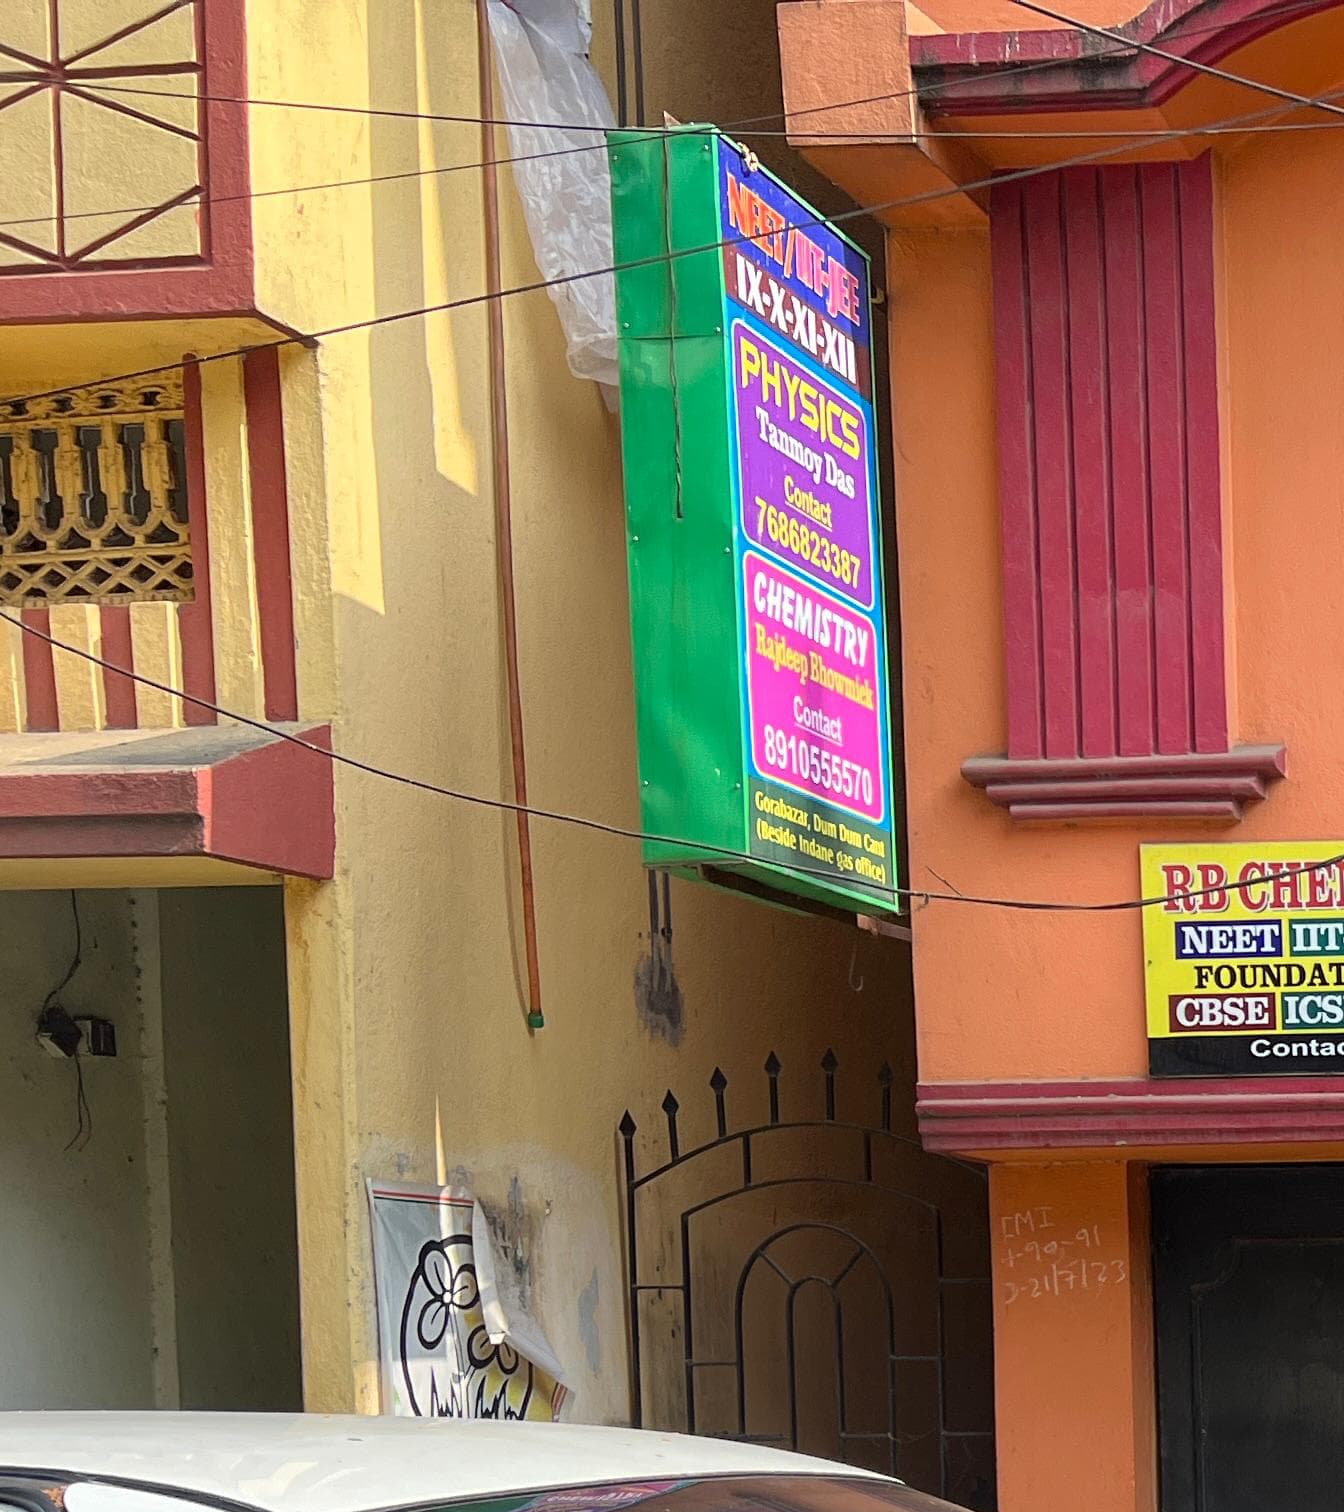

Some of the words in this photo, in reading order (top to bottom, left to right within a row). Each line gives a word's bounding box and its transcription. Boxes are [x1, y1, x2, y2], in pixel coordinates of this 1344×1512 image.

[736, 253, 857, 384] IX-X-XI-XII
[740, 336, 860, 460] PHYSICS
[755, 405, 823, 485] Tanmoy
[823, 451, 856, 499] Das
[784, 475, 833, 529] Contact
[755, 496, 861, 589] 7686823387
[754, 571, 868, 668] CHEMISTRY
[755, 621, 809, 686] Rajdeep
[793, 695, 842, 741] Contact
[764, 725, 873, 806] 8910555570
[757, 817, 797, 850] (Beside
[799, 834, 834, 864] Indane
[836, 850, 854, 872] gas
[854, 856, 886, 885] office)
[813, 813, 838, 840] Dum
[838, 823, 862, 849] Dum
[1161, 864, 1229, 913] RB
[1181, 924, 1282, 954] NEET
[1176, 996, 1270, 1027] CBSE
